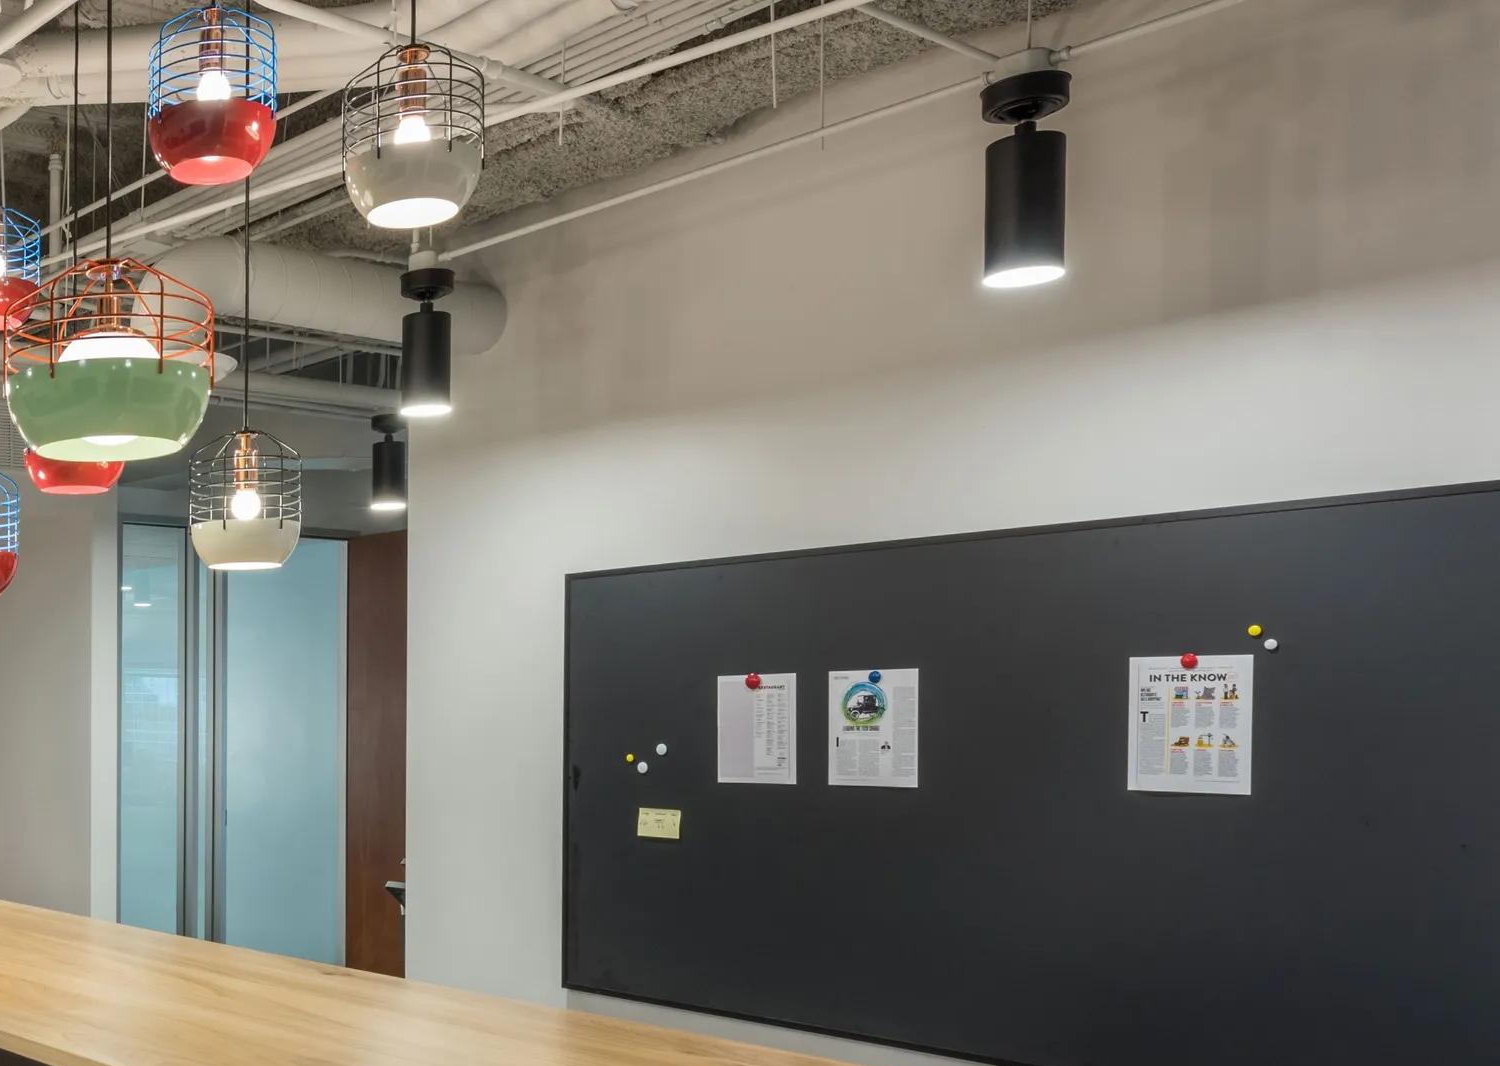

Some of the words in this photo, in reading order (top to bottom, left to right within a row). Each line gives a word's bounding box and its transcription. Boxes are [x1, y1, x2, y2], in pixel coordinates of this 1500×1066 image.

[1149, 674, 1162, 682] IN
[1164, 674, 1187, 682] THE
[1190, 673, 1227, 682] KNOW
[1140, 711, 1149, 723] T
